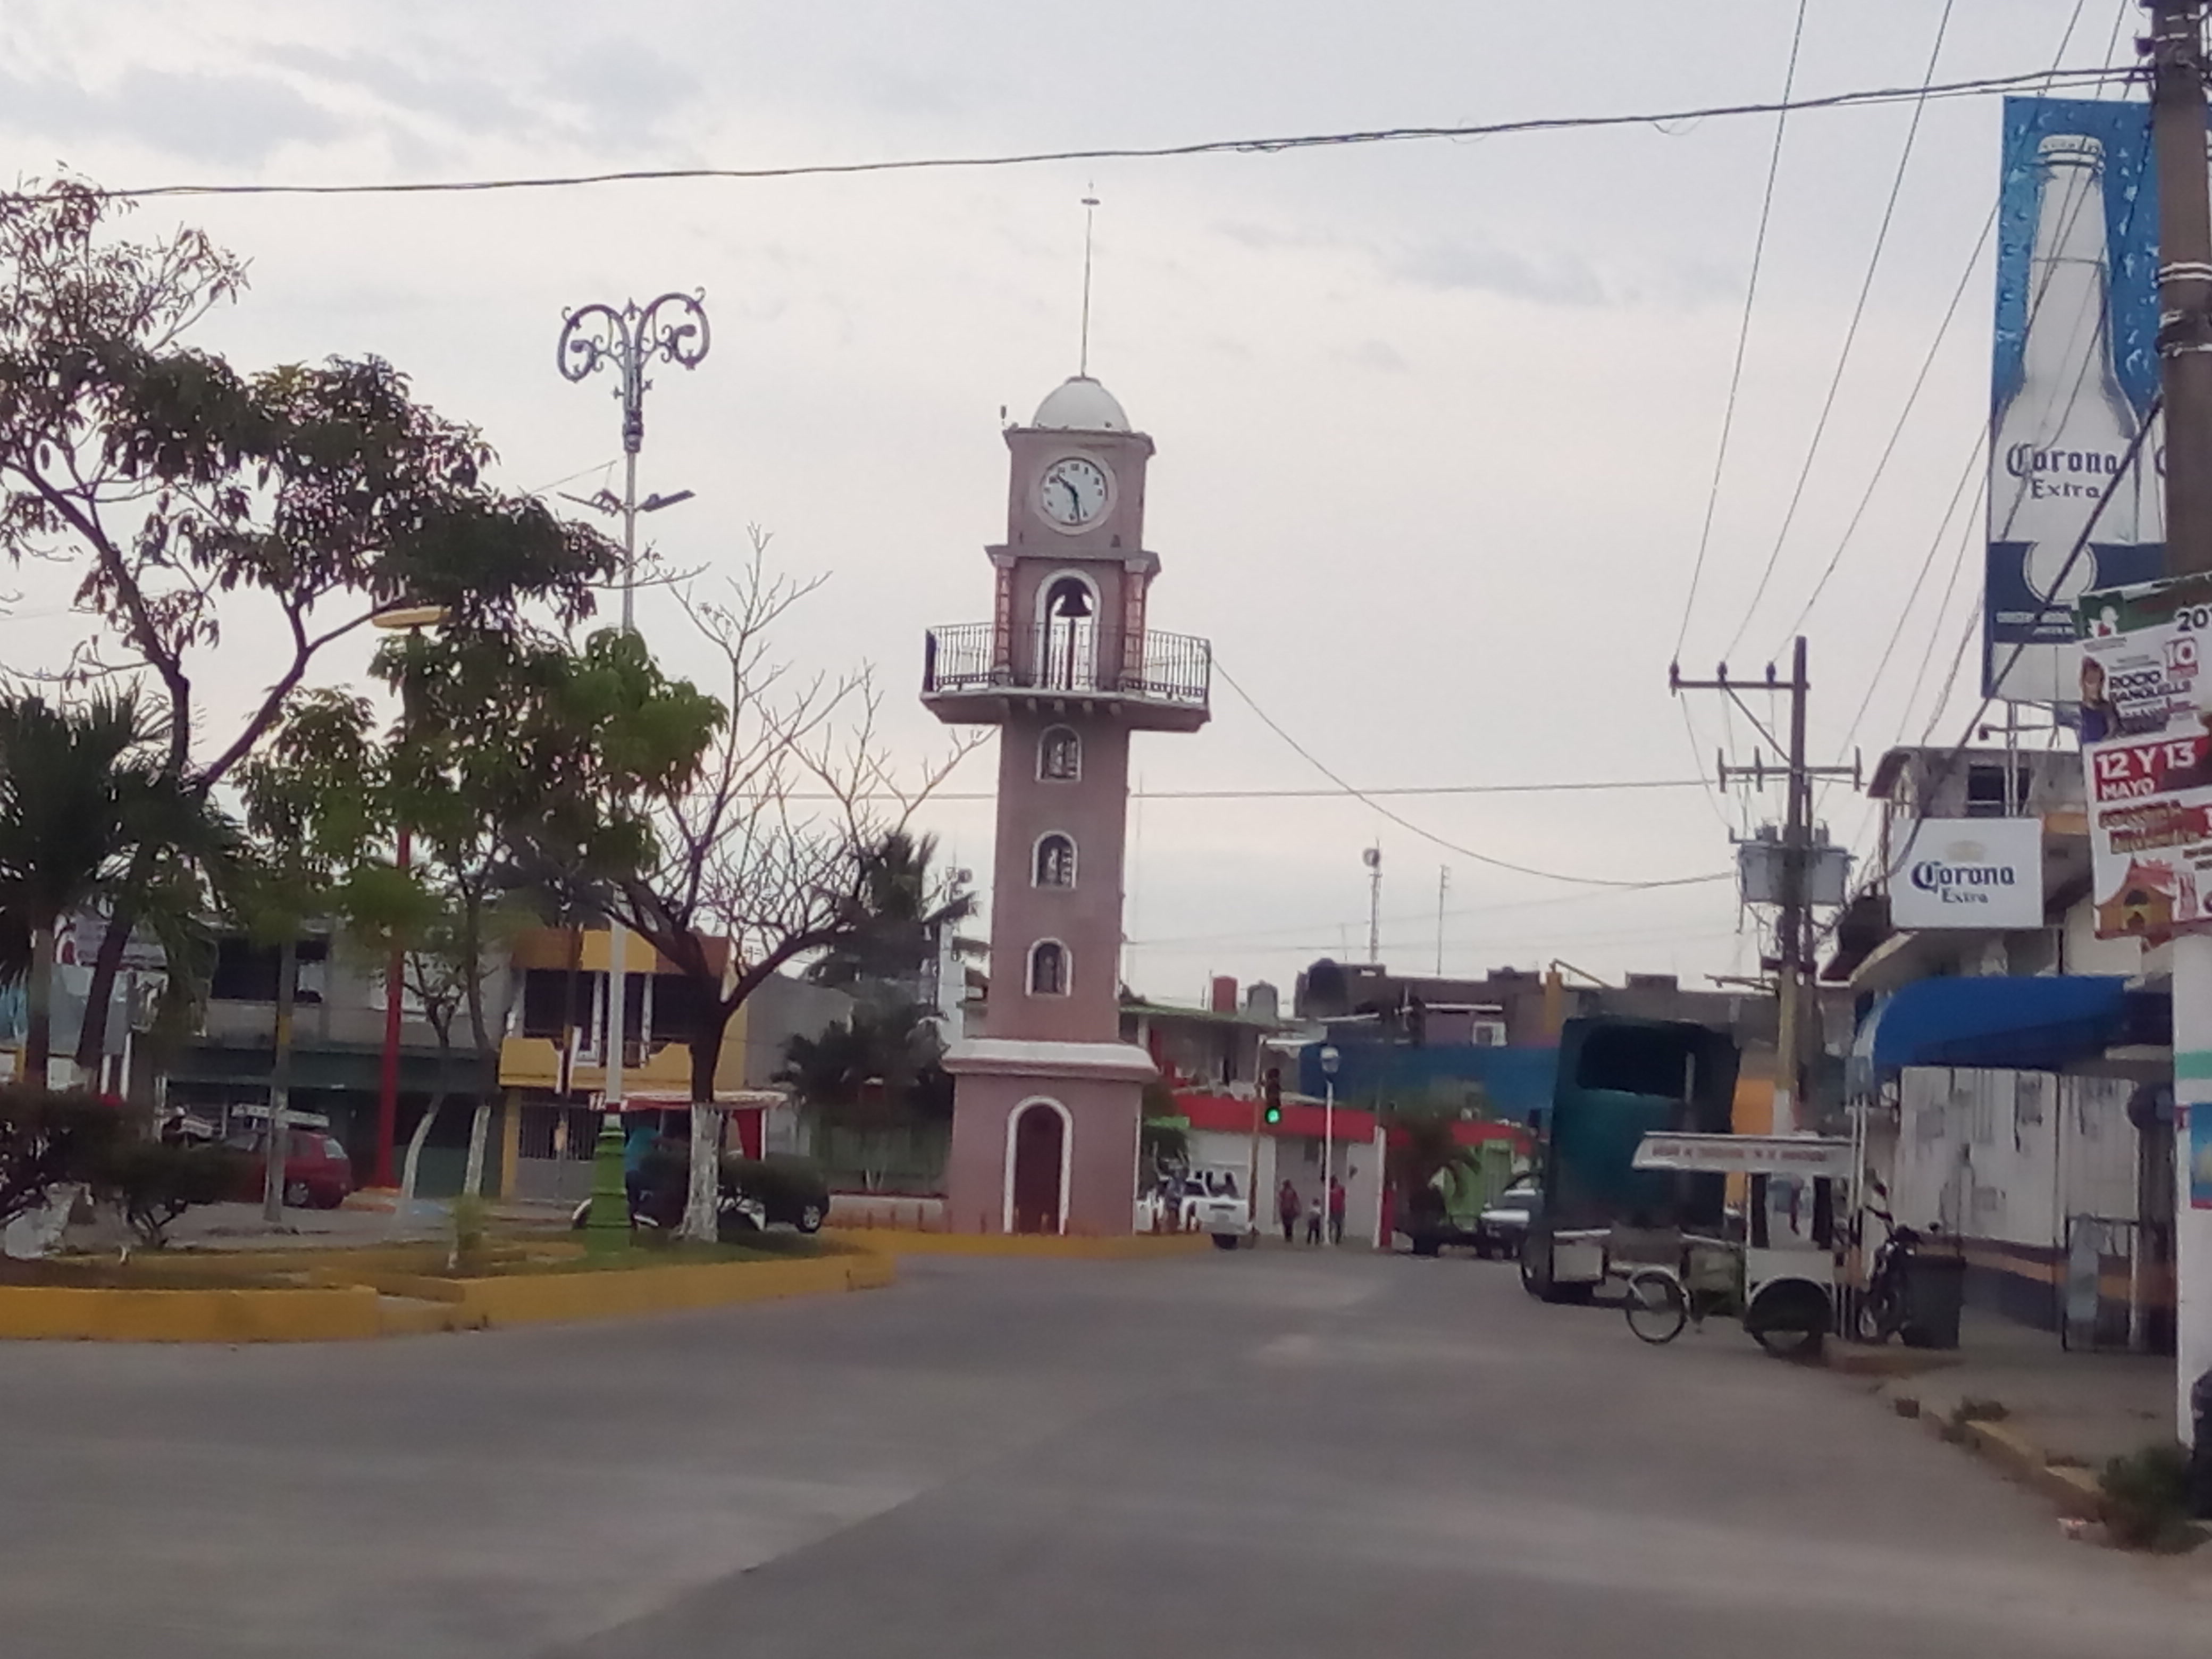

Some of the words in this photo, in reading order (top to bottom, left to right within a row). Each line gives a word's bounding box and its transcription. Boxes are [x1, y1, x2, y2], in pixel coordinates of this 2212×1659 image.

[2007, 442, 2118, 477] Corona
[2031, 479, 2101, 499] Extra
[2163, 640, 2196, 667] 10
[2097, 753, 2131, 779] 12
[2134, 747, 2156, 773] Y
[2163, 741, 2196, 769] 13
[2101, 777, 2155, 800] MAYO
[1911, 860, 2015, 893] Corona
[1941, 887, 1989, 903] Extra
